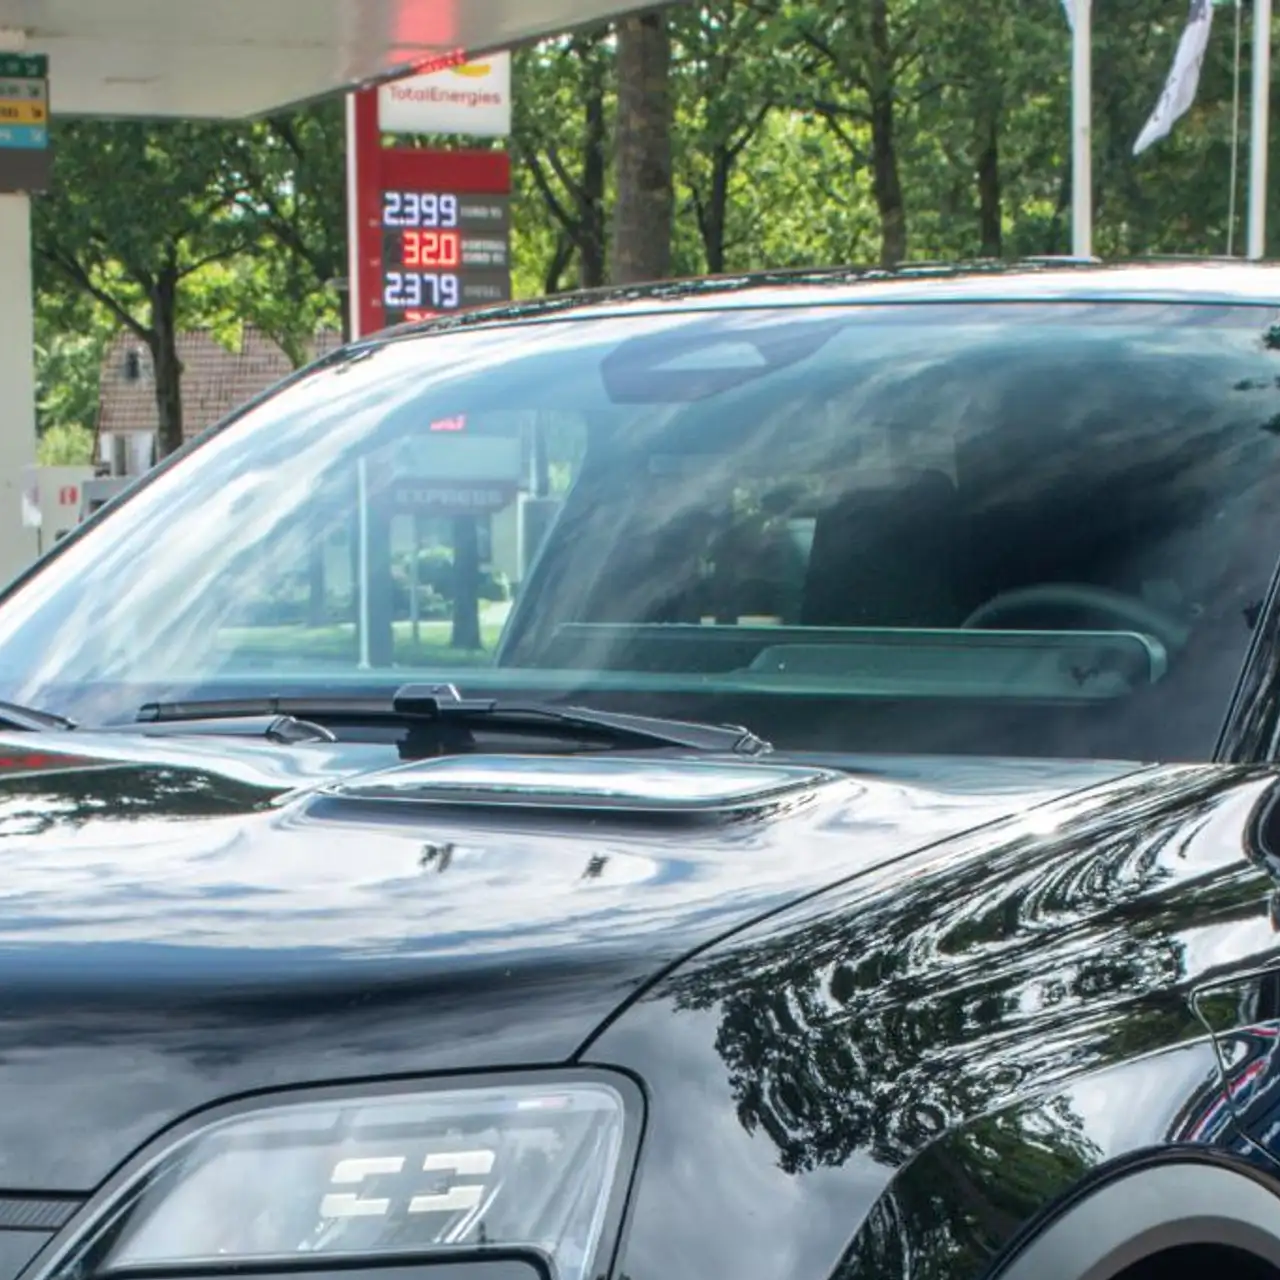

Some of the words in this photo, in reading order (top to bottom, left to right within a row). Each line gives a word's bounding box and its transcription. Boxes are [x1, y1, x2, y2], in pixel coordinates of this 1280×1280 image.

[389, 86, 502, 107] TotalEnergies
[383, 191, 458, 228] 2.399
[384, 271, 459, 308] 2.379
